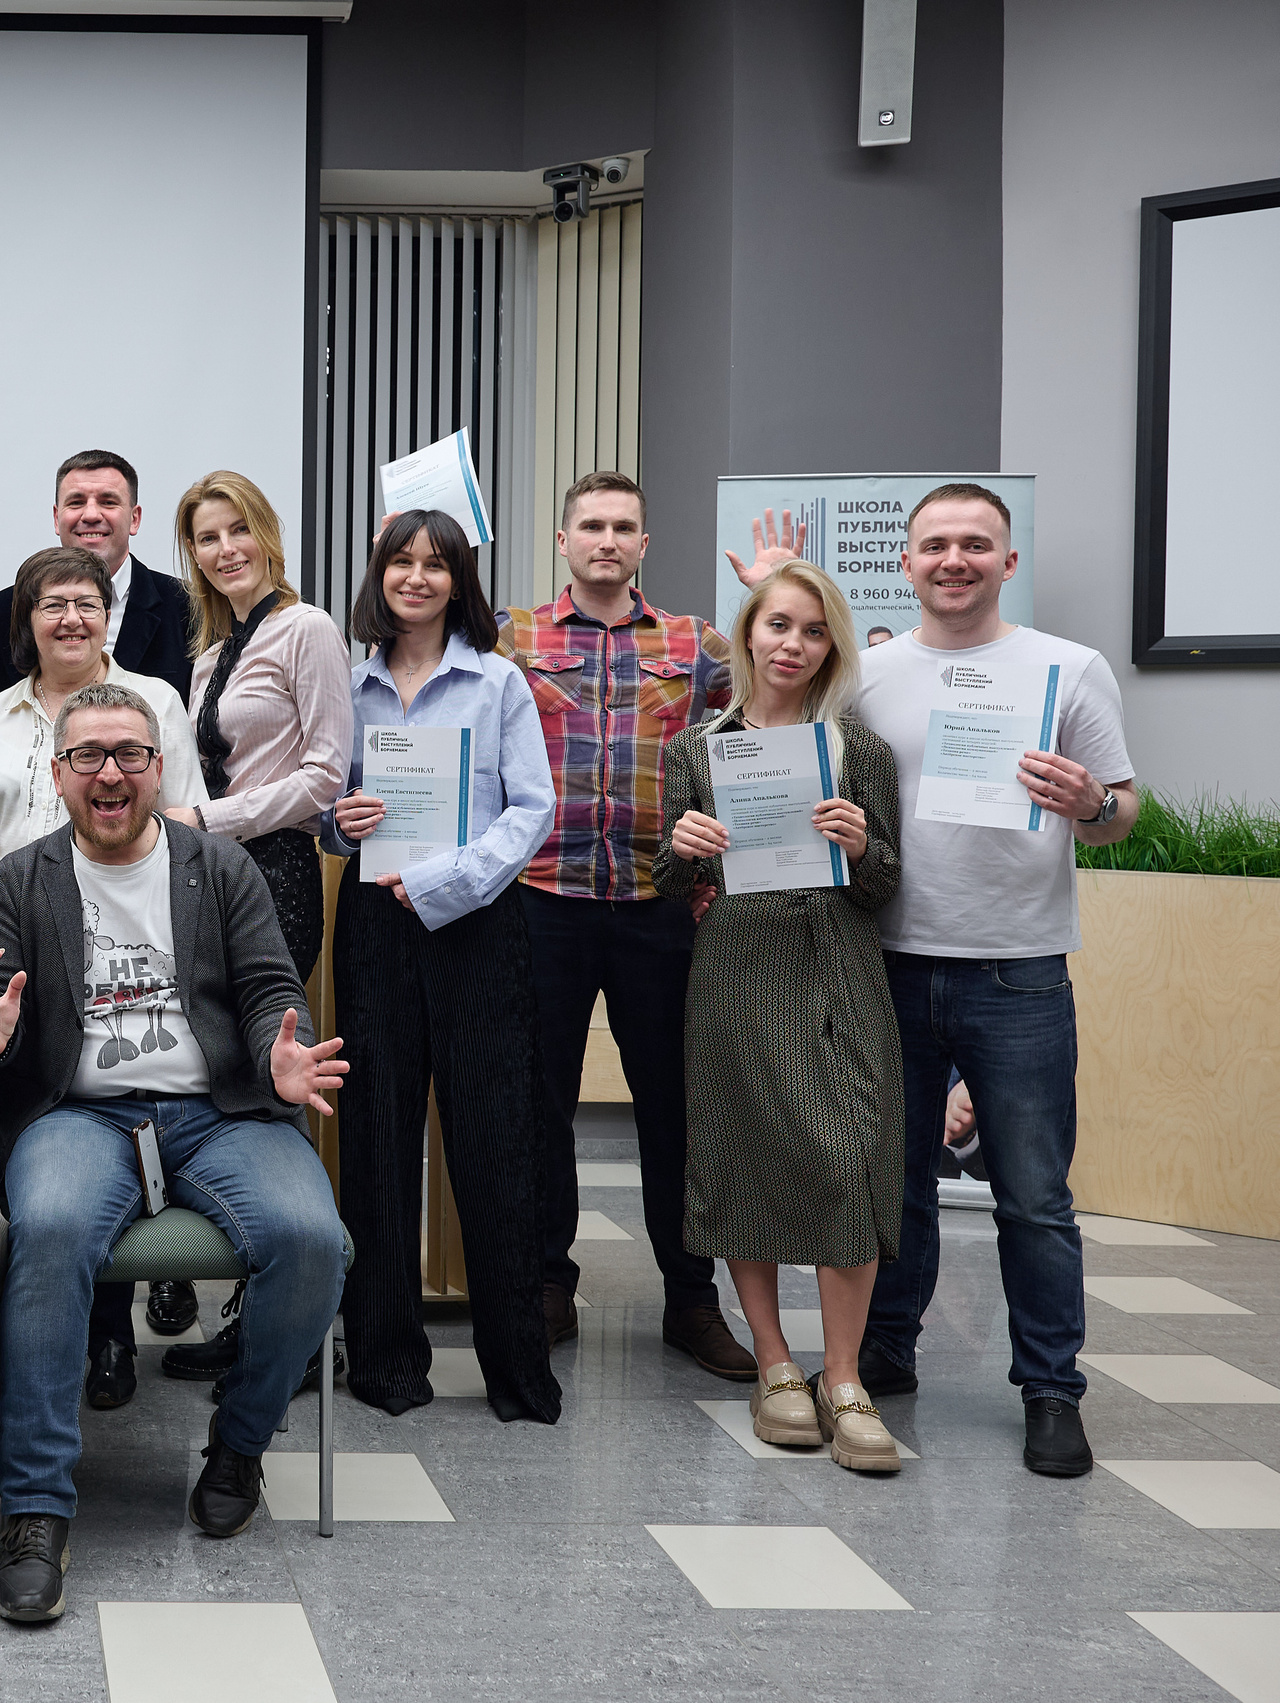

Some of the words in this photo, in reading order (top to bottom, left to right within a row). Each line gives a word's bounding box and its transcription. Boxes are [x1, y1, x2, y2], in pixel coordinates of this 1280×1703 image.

[837, 501, 904, 514] ШКОЛА
[850, 588, 859, 600] 8
[863, 588, 890, 600] 960
[848, 603, 915, 611] оцалистический,
[958, 702, 1016, 712] СЕРТИФИКАТ
[385, 766, 436, 774] СЕРТИФИКАТ
[736, 768, 792, 780] СЕРТИФИКАТ
[109, 957, 153, 981] НЕ
